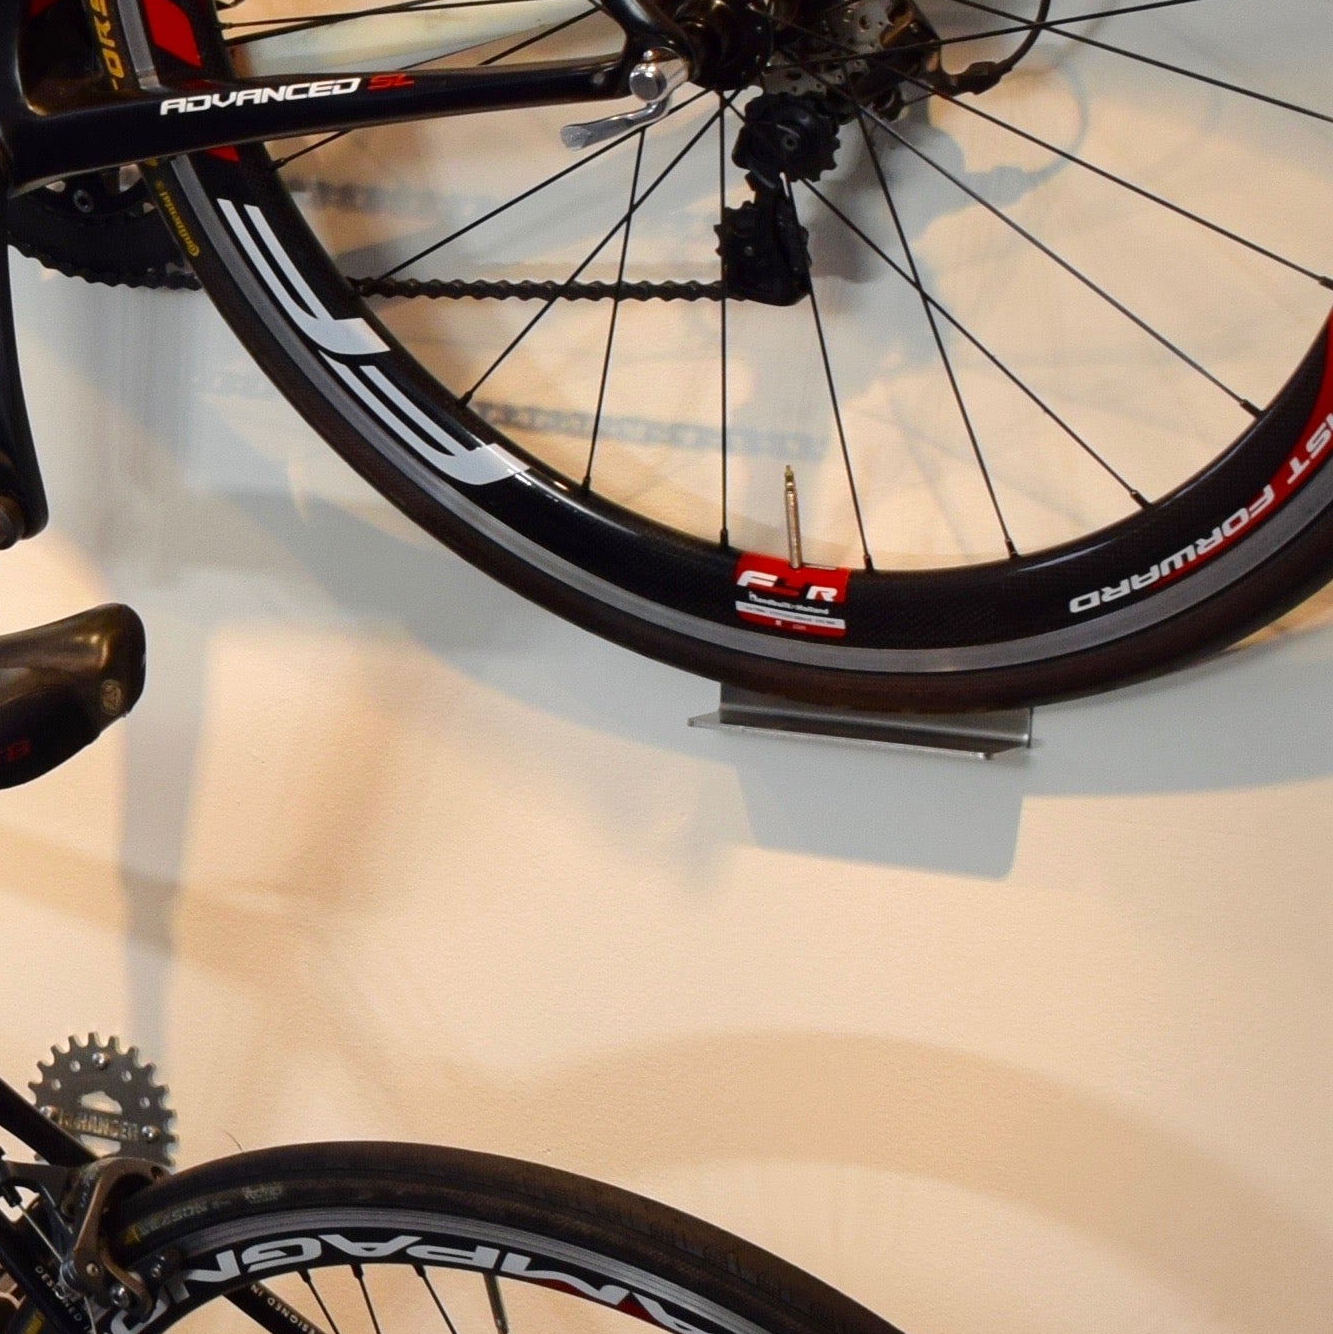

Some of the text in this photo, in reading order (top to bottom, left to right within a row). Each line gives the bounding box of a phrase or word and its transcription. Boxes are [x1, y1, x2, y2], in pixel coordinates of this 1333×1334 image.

[160, 77, 360, 116] ADVANCED
[1069, 483, 1275, 614] FORWARD
[250, 1283, 265, 1297] IN
